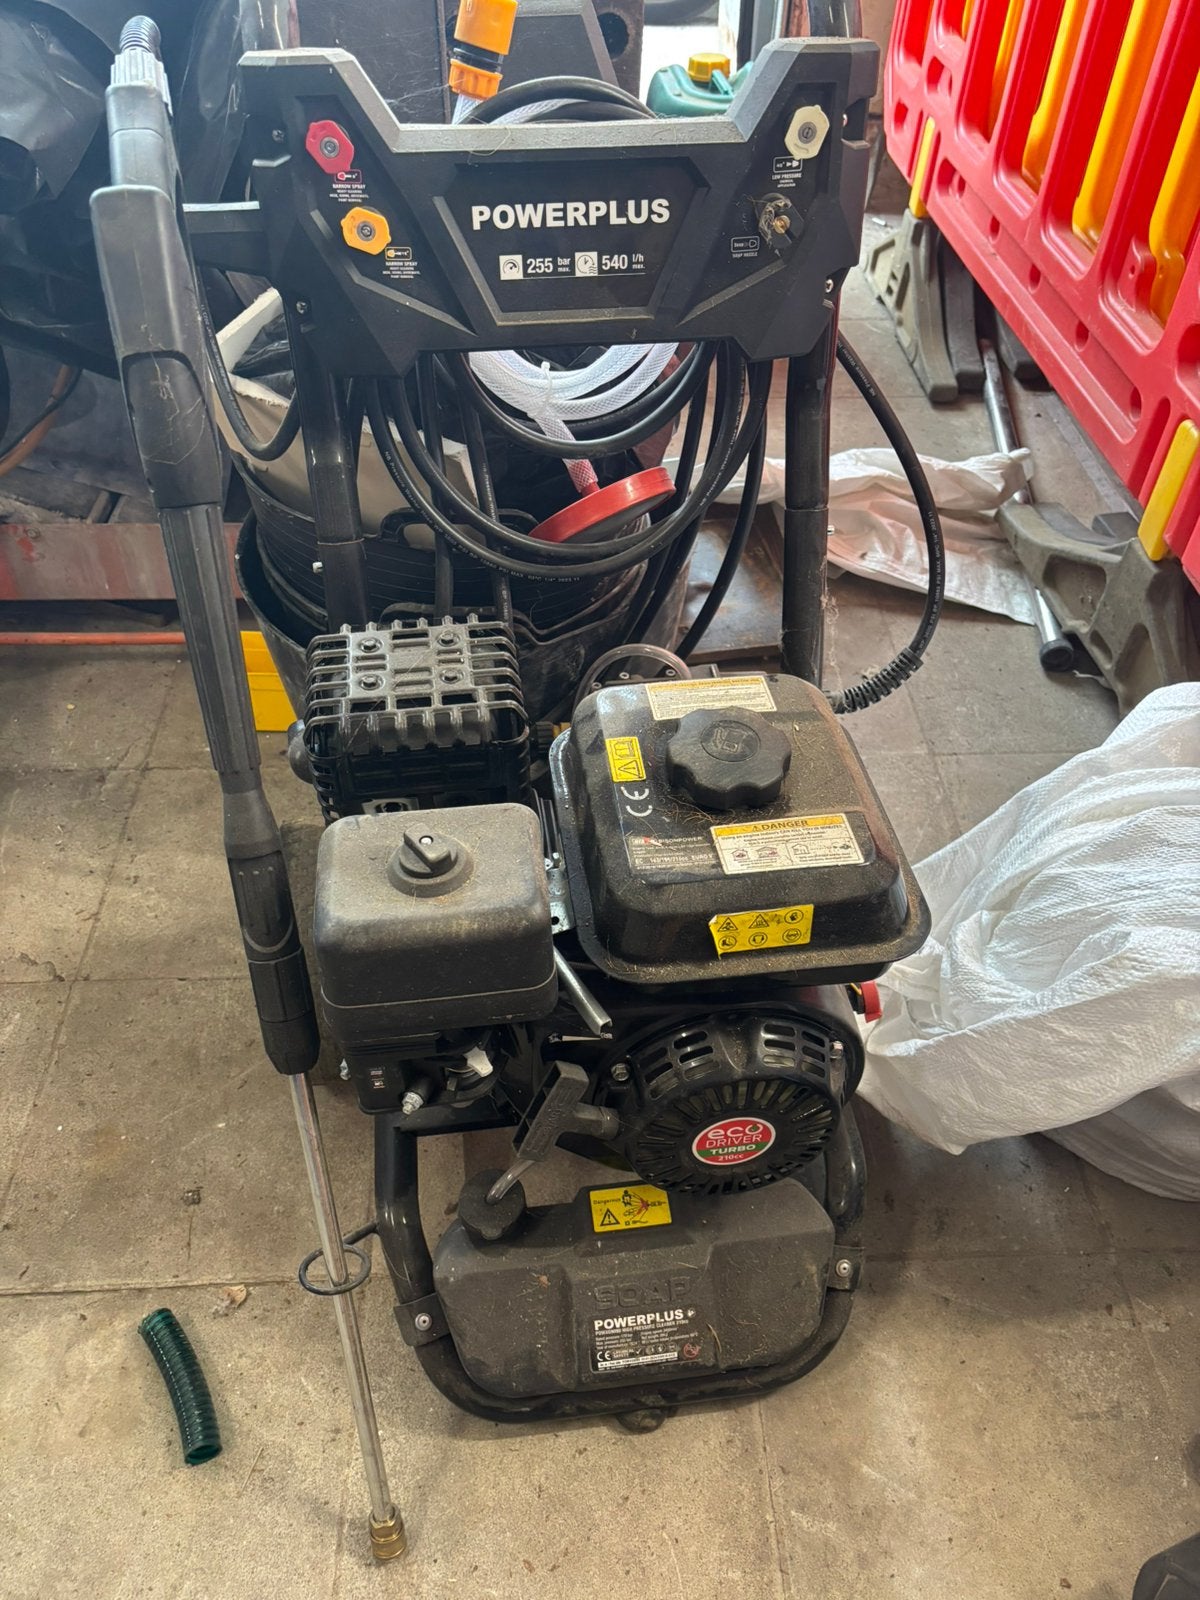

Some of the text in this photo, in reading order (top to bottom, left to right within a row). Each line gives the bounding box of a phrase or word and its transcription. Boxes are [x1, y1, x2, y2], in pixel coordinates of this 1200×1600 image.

[471, 198, 671, 231] POWERPLUS
[526, 257, 570, 274] 255 bar
[602, 253, 644, 270] 540 l/h
[632, 262, 646, 270] max.
[761, 820, 809, 830] DANGER
[707, 1124, 763, 1139] eco
[706, 1134, 762, 1148] DRIVER
[710, 1144, 756, 1155] TURBO
[593, 1276, 692, 1310] SOAP
[594, 1309, 684, 1330] POWERPLUS
[597, 1350, 611, 1361] CE
